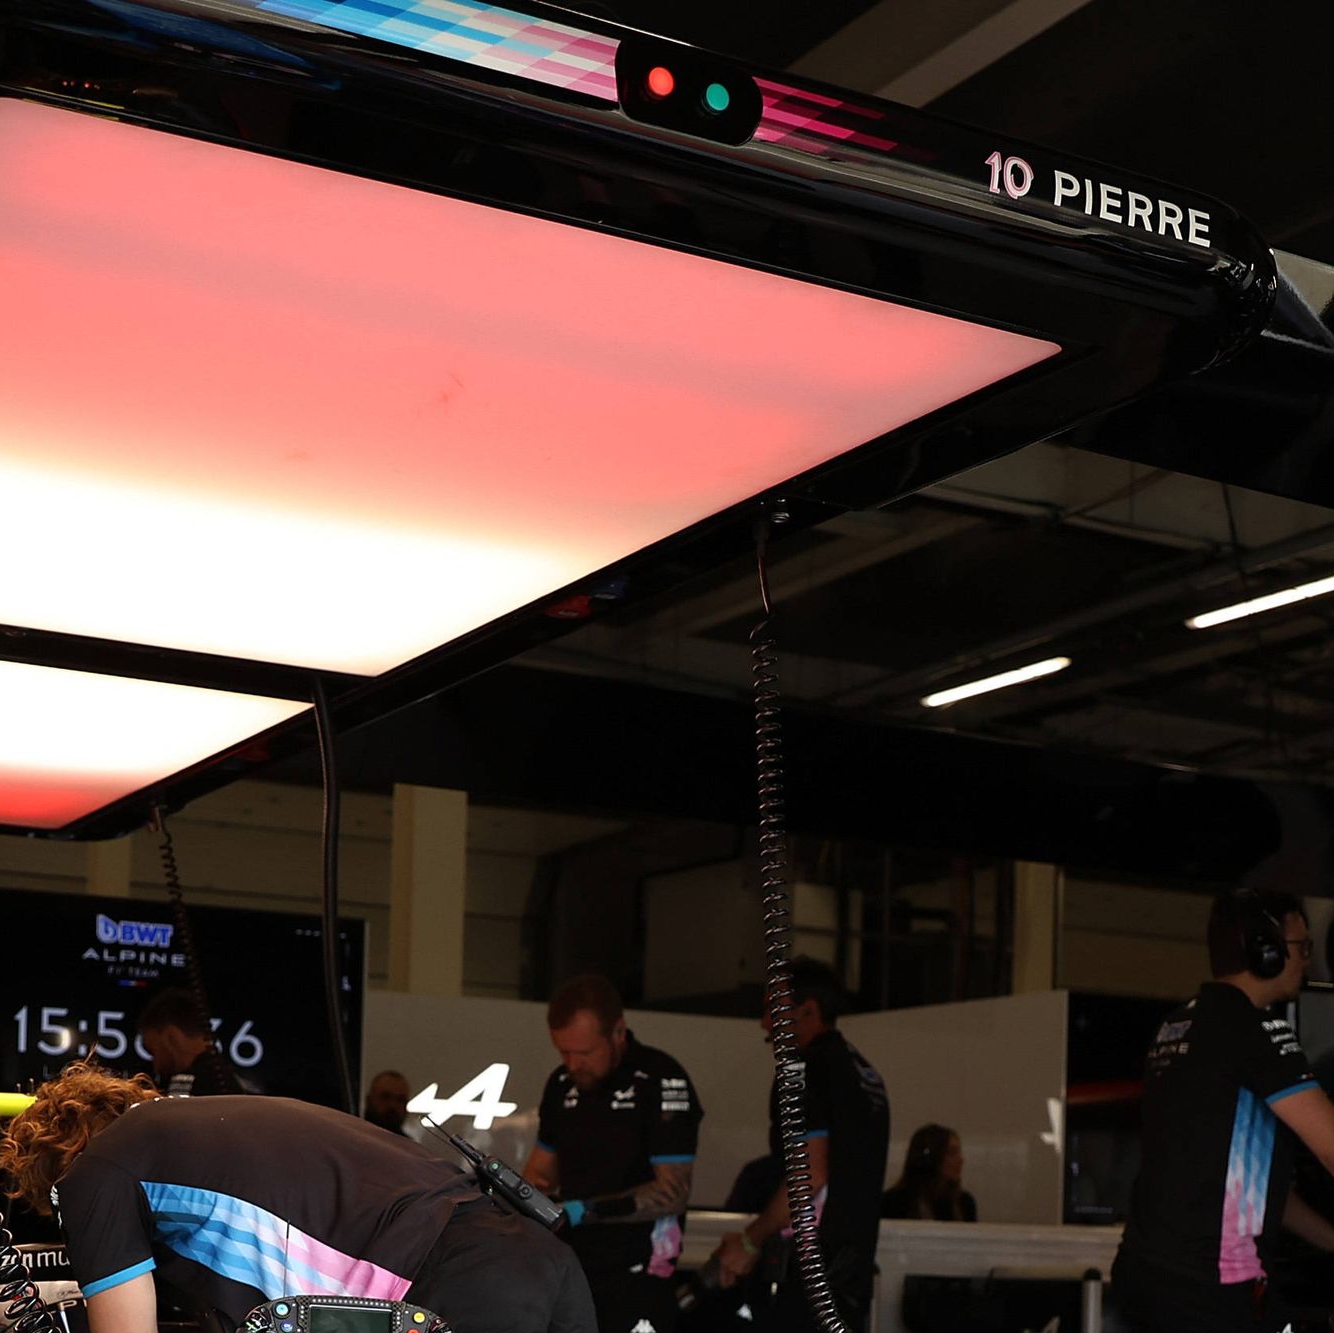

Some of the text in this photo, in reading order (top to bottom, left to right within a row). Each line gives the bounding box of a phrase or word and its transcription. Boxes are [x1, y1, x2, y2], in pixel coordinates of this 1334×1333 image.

[985, 151, 1211, 248] 10 PIERRE
[118, 919, 174, 948] BWT
[81, 946, 188, 968] ALPINE
